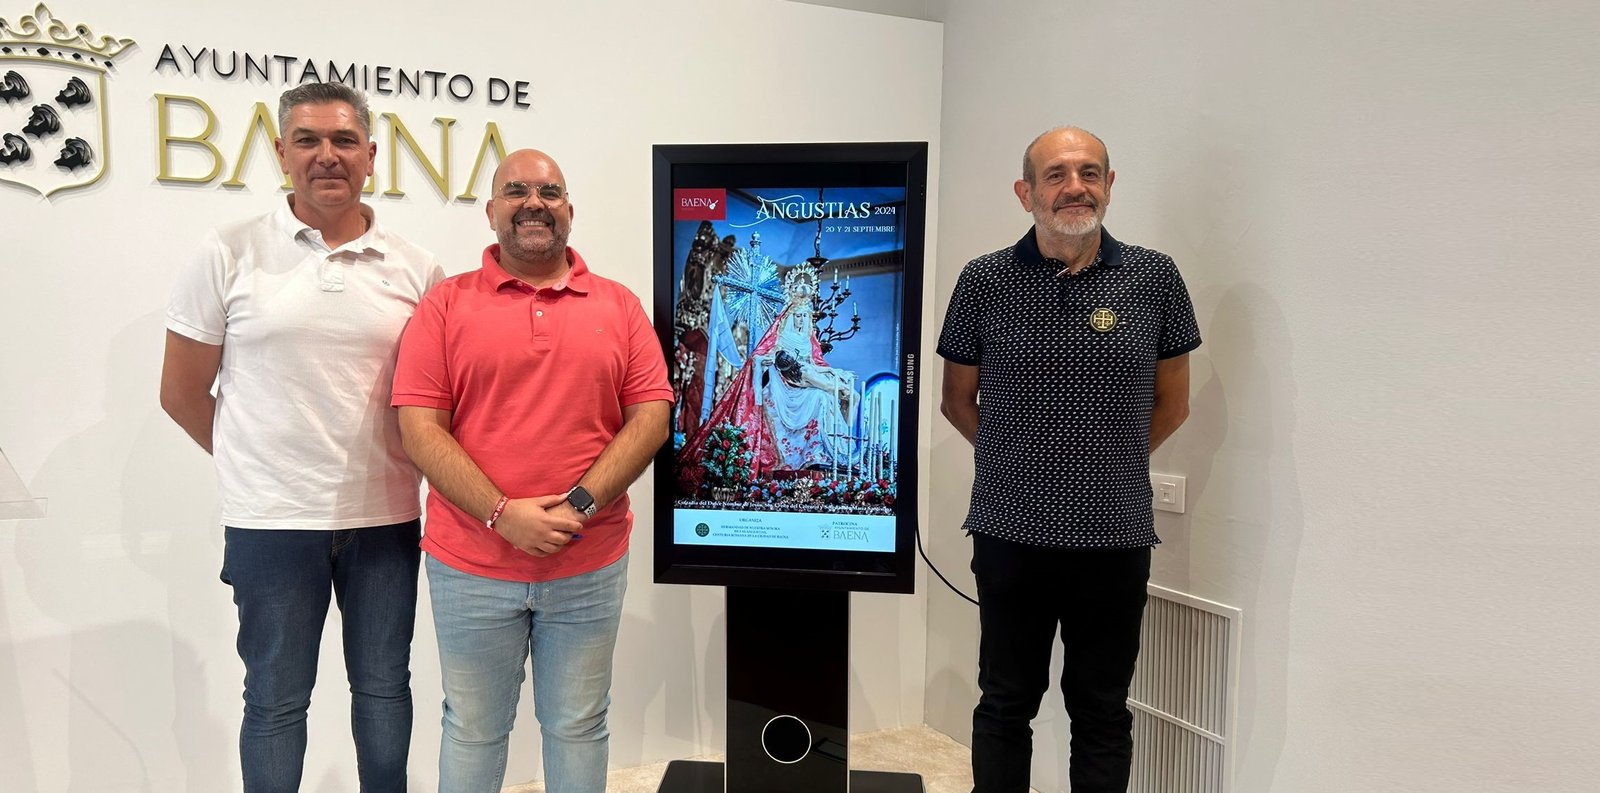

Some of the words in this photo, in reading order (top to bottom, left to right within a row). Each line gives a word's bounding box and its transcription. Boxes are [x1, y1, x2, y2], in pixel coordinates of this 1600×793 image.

[154, 43, 474, 101] AYUNTAMIENTO
[488, 77, 531, 108] DE
[153, 92, 510, 203] BANA
[681, 197, 713, 208] BAENA
[754, 197, 871, 220] ANGUSTIAS
[874, 206, 896, 215] 2024
[825, 225, 835, 233] 20
[836, 225, 843, 233] Y
[844, 225, 851, 233] 21
[852, 225, 896, 233] SEPTIEMBRE
[906, 353, 915, 394] SAMSUNG
[833, 530, 869, 543] BAENA
